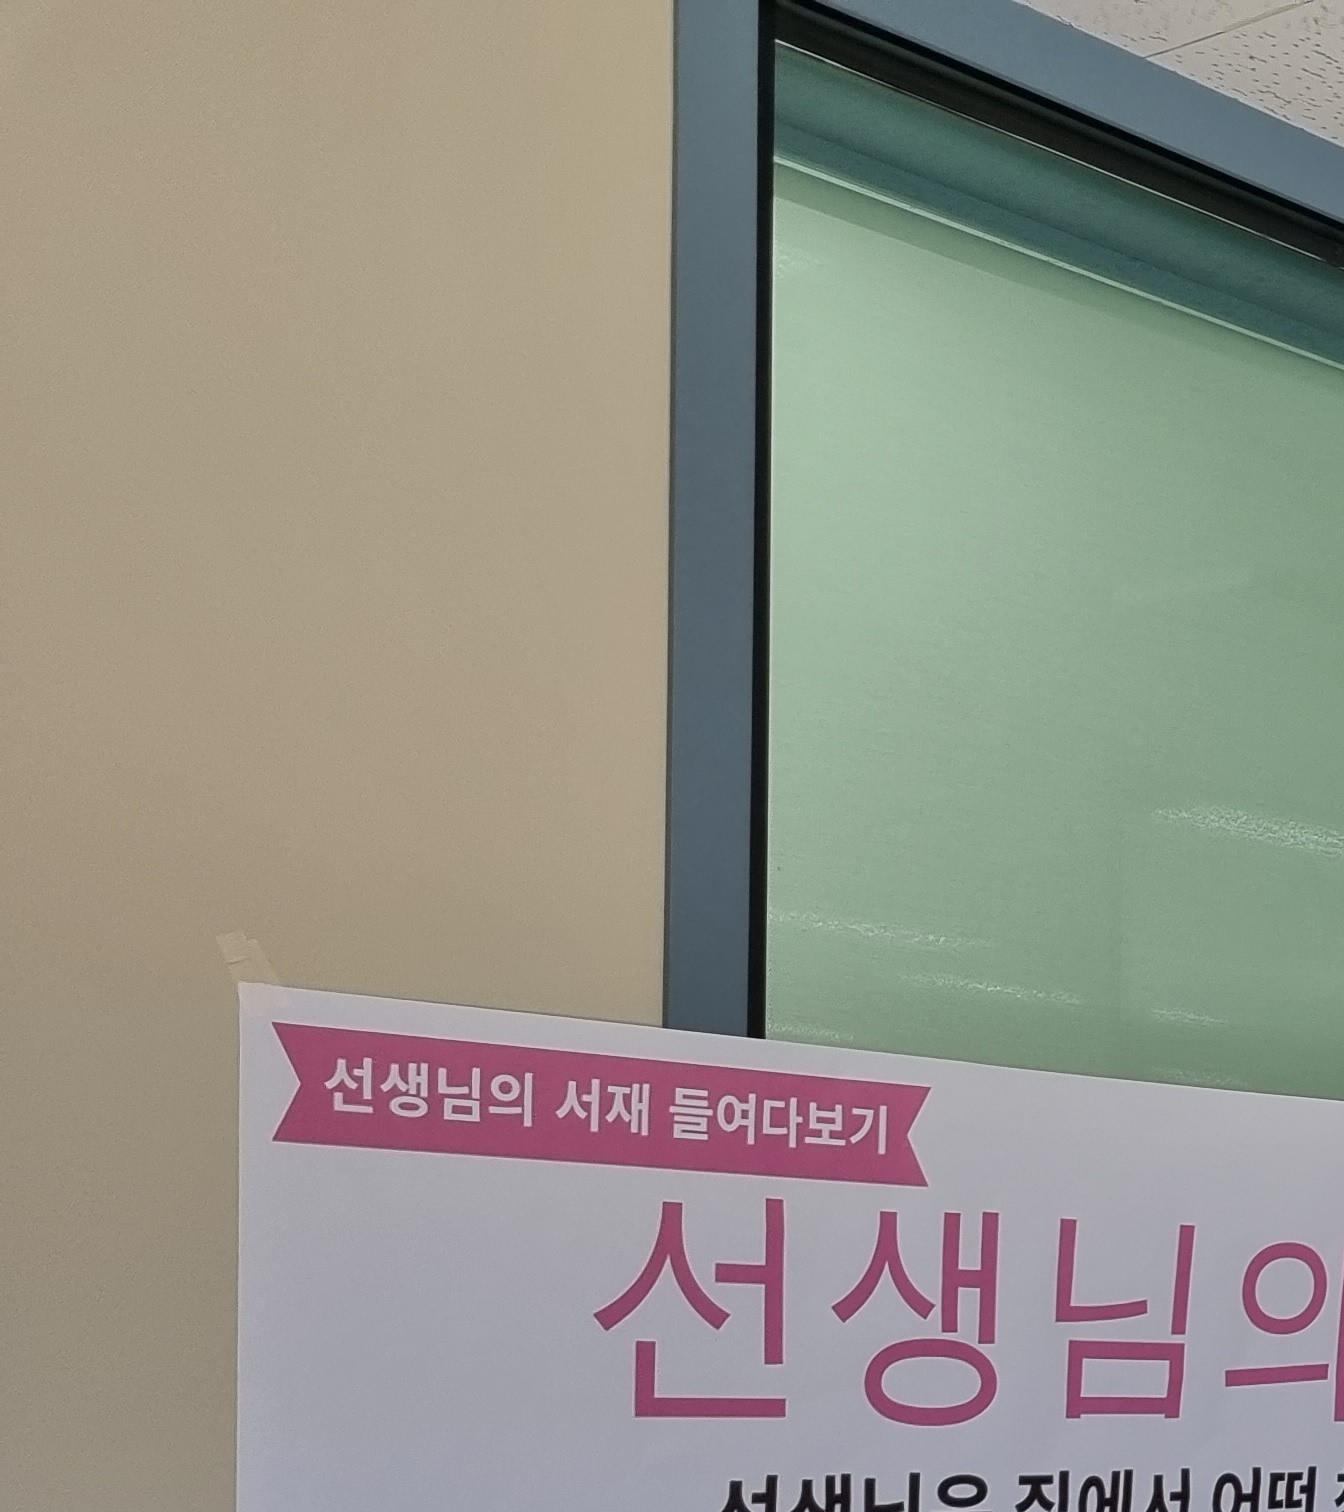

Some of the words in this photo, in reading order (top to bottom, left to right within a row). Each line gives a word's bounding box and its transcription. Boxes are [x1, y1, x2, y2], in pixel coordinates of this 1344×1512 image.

[325, 1057, 535, 1126] 선생님의
[556, 1077, 652, 1137] 서재
[668, 1090, 891, 1156] 들여다보기
